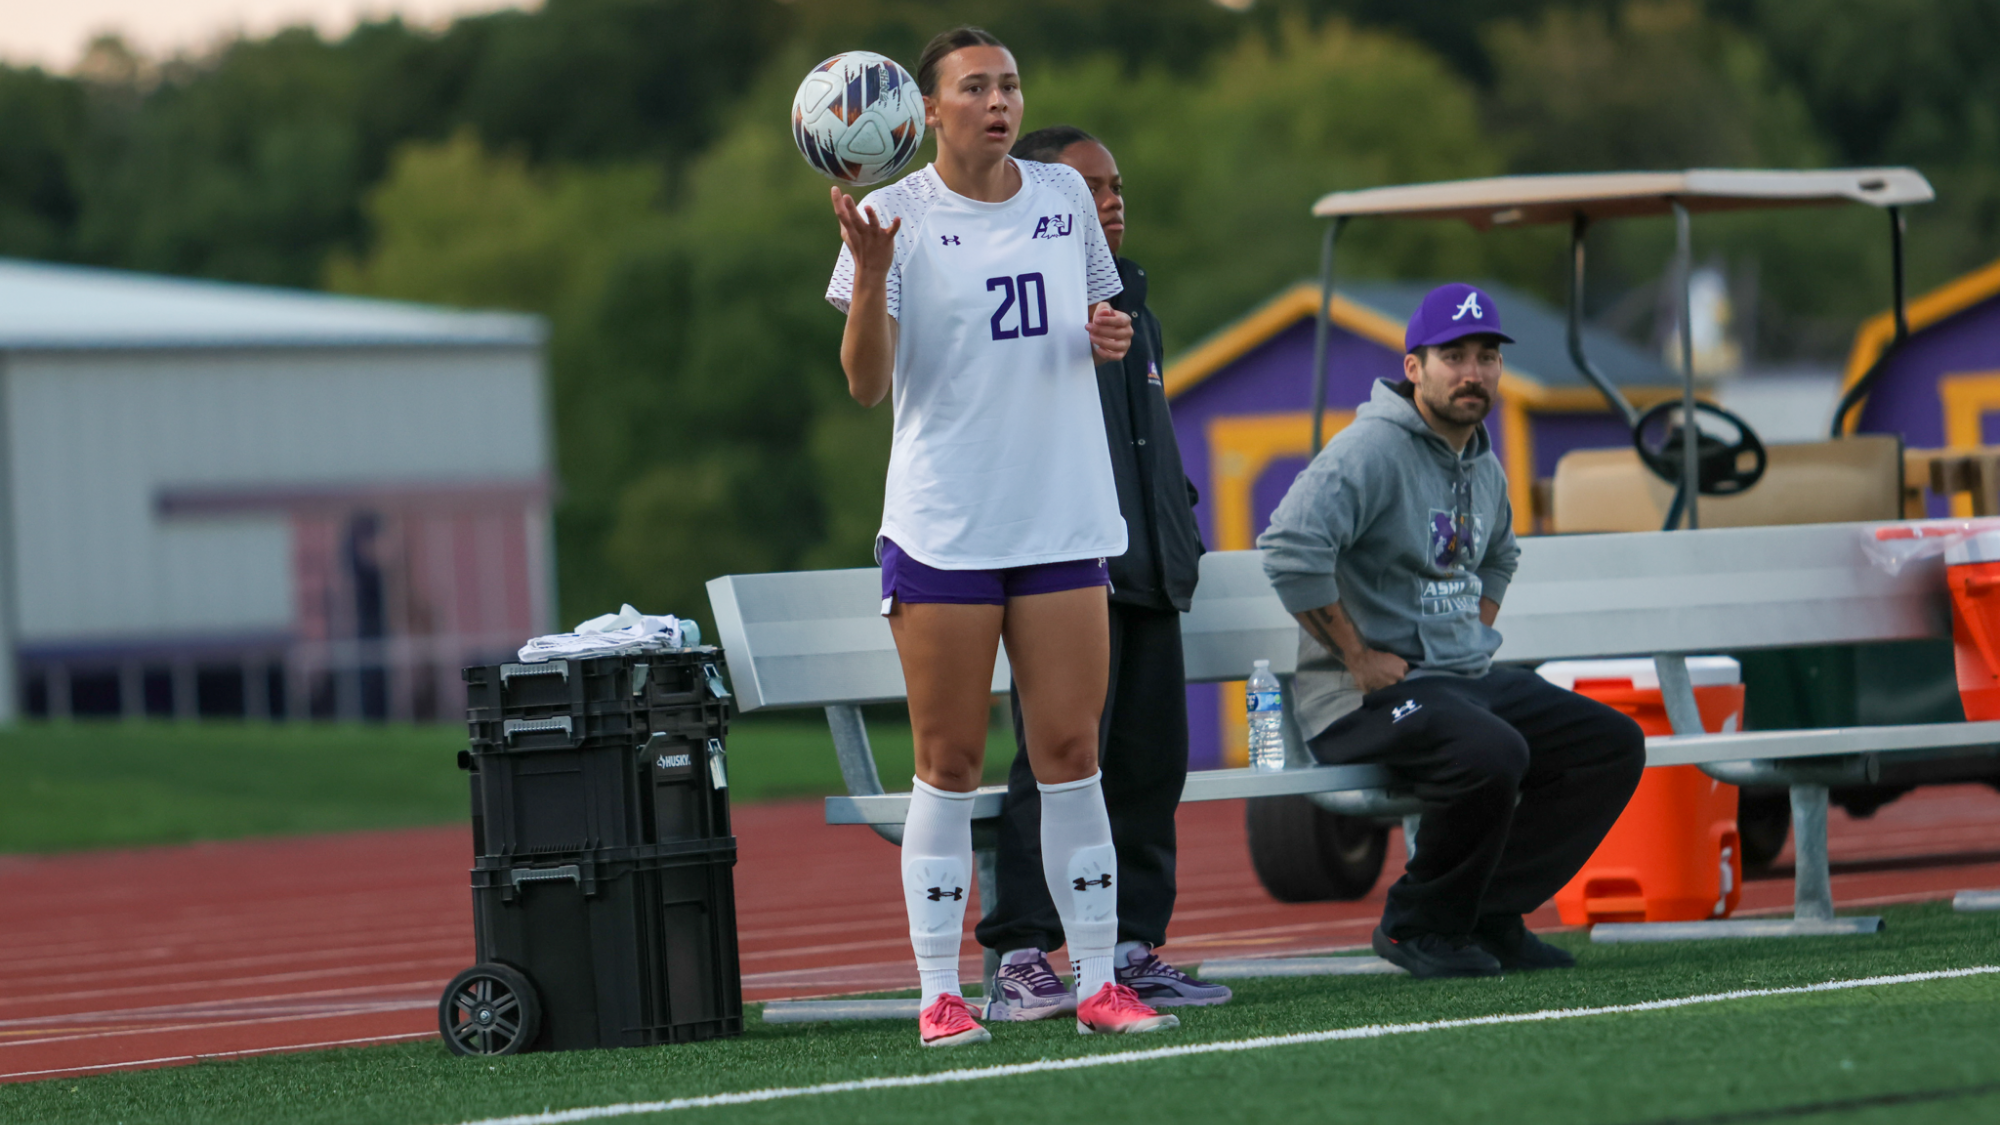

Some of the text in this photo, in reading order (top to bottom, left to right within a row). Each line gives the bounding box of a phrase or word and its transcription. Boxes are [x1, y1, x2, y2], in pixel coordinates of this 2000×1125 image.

[986, 272, 1048, 341] 20
[1452, 292, 1483, 320] A
[665, 754, 689, 767] HUSKY
